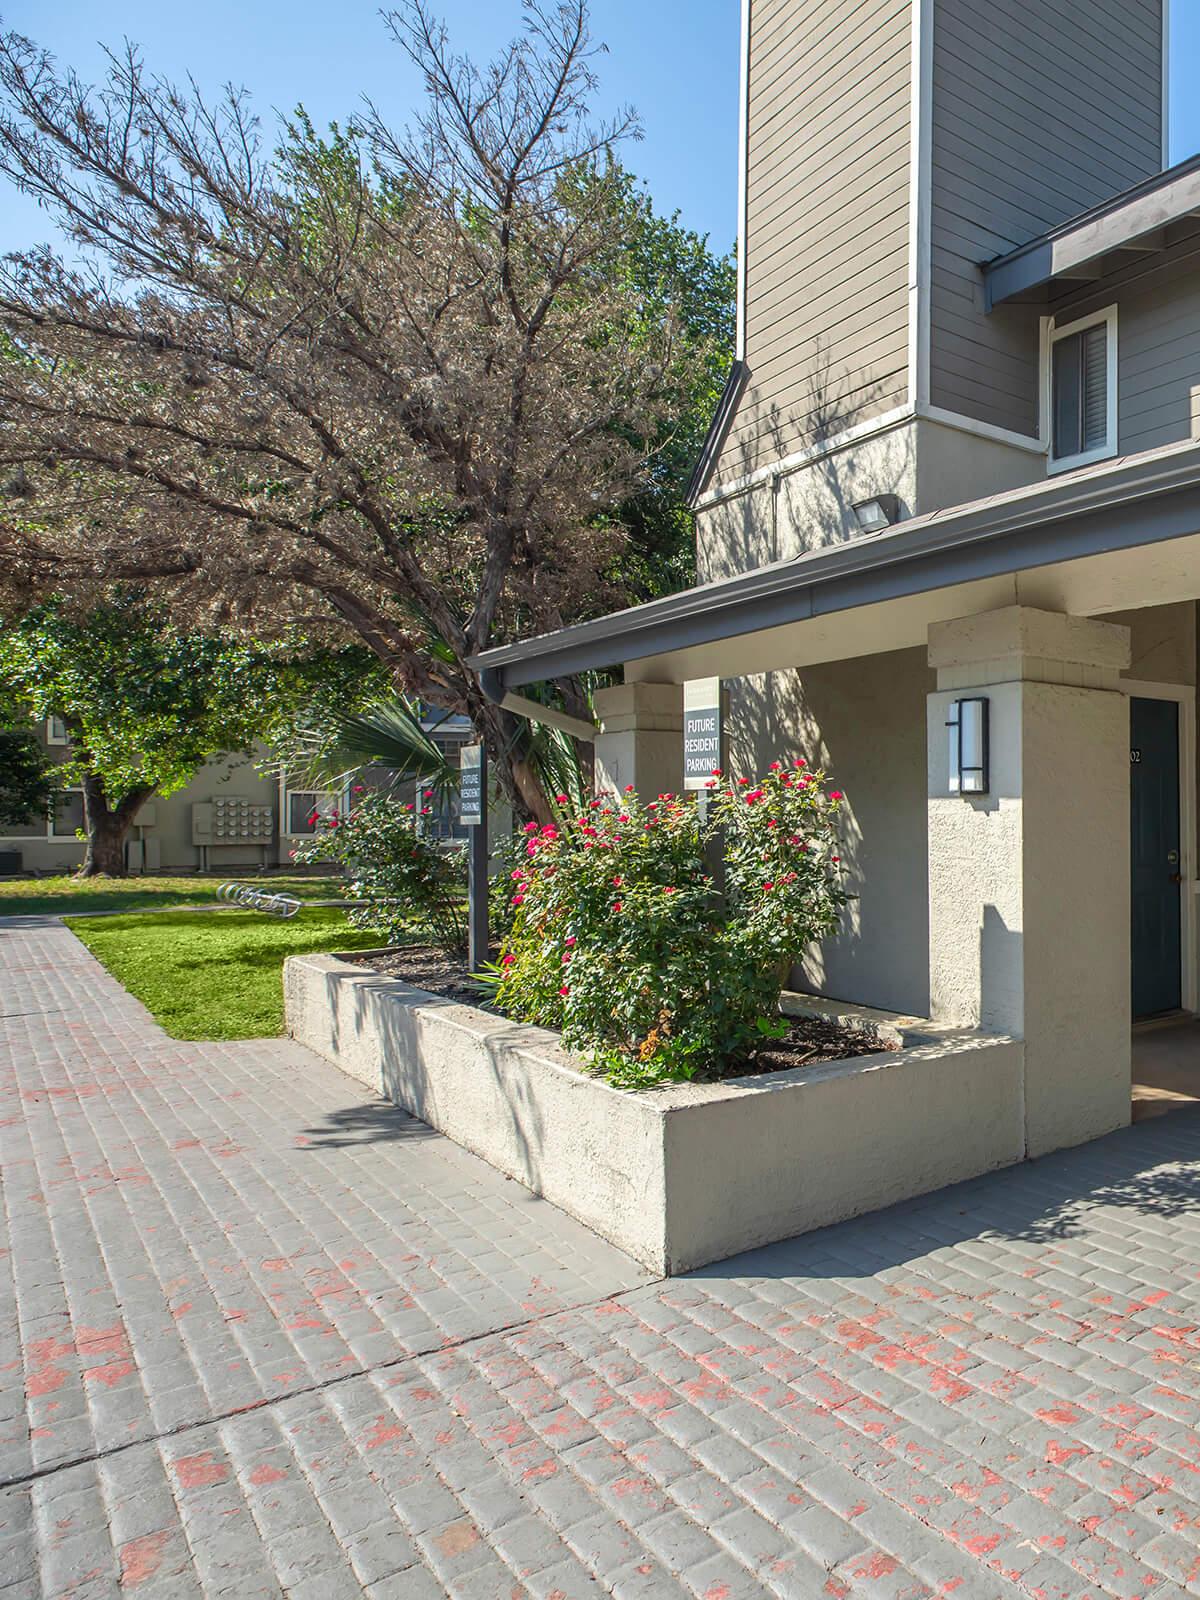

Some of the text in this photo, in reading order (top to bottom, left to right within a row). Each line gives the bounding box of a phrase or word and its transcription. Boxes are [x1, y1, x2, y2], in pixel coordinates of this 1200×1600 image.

[687, 718, 715, 733] FUTURE
[684, 737, 718, 753] RESIDENT
[686, 757, 717, 772] PARKING
[462, 774, 479, 785] FUTURE
[462, 801, 480, 812] PARKING
